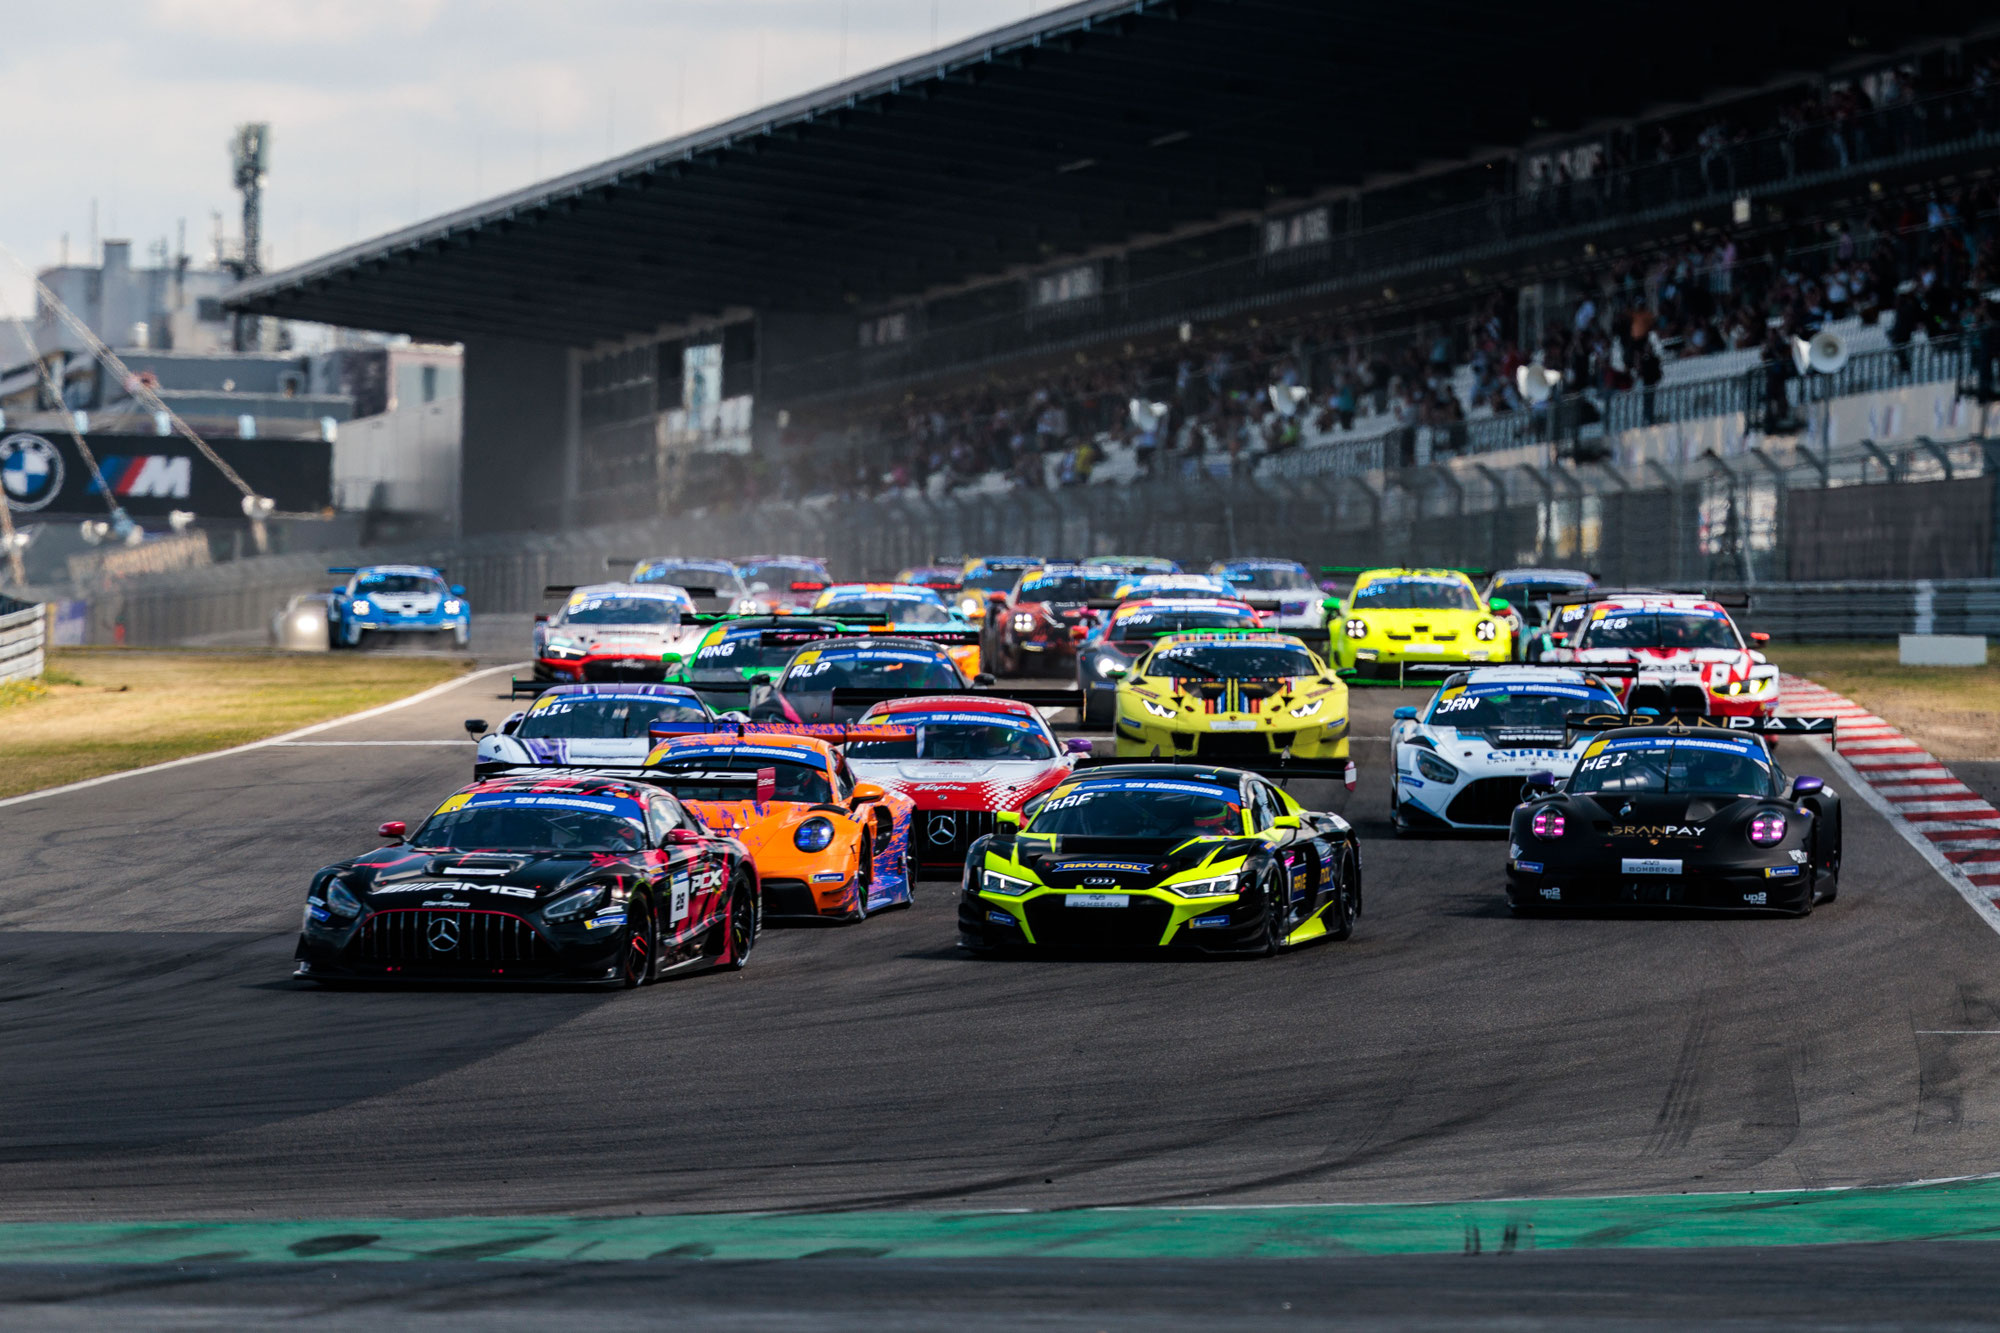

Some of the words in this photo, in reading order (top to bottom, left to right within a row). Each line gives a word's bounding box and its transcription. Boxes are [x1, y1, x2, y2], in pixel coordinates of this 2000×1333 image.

[789, 661, 832, 679] ALP
[1525, 684, 1591, 698] NÜRBURGRING
[1436, 697, 1480, 715] JAN
[931, 714, 950, 722] 12H
[950, 713, 1020, 728] NÜRBURGRING
[1583, 714, 1825, 731] GRANPAY
[733, 745, 808, 760] NÜRBURGRING
[1655, 738, 1674, 746] 12H
[1674, 739, 1749, 754] NÜRBURGRING
[1580, 752, 1629, 773] HEI
[1124, 781, 1146, 789] 12H
[1146, 781, 1224, 797] NÜRBURGRING
[514, 796, 537, 805] 12H
[536, 796, 617, 812] NÜRBURGRING
[1043, 792, 1095, 813] KAF
[1609, 825, 1706, 836] GRANPAY
[1062, 862, 1143, 871] RAVENOL
[690, 869, 724, 894] PCX
[422, 881, 537, 899] AMG
[1540, 887, 1561, 900] up2
[1743, 891, 1767, 903] up2
